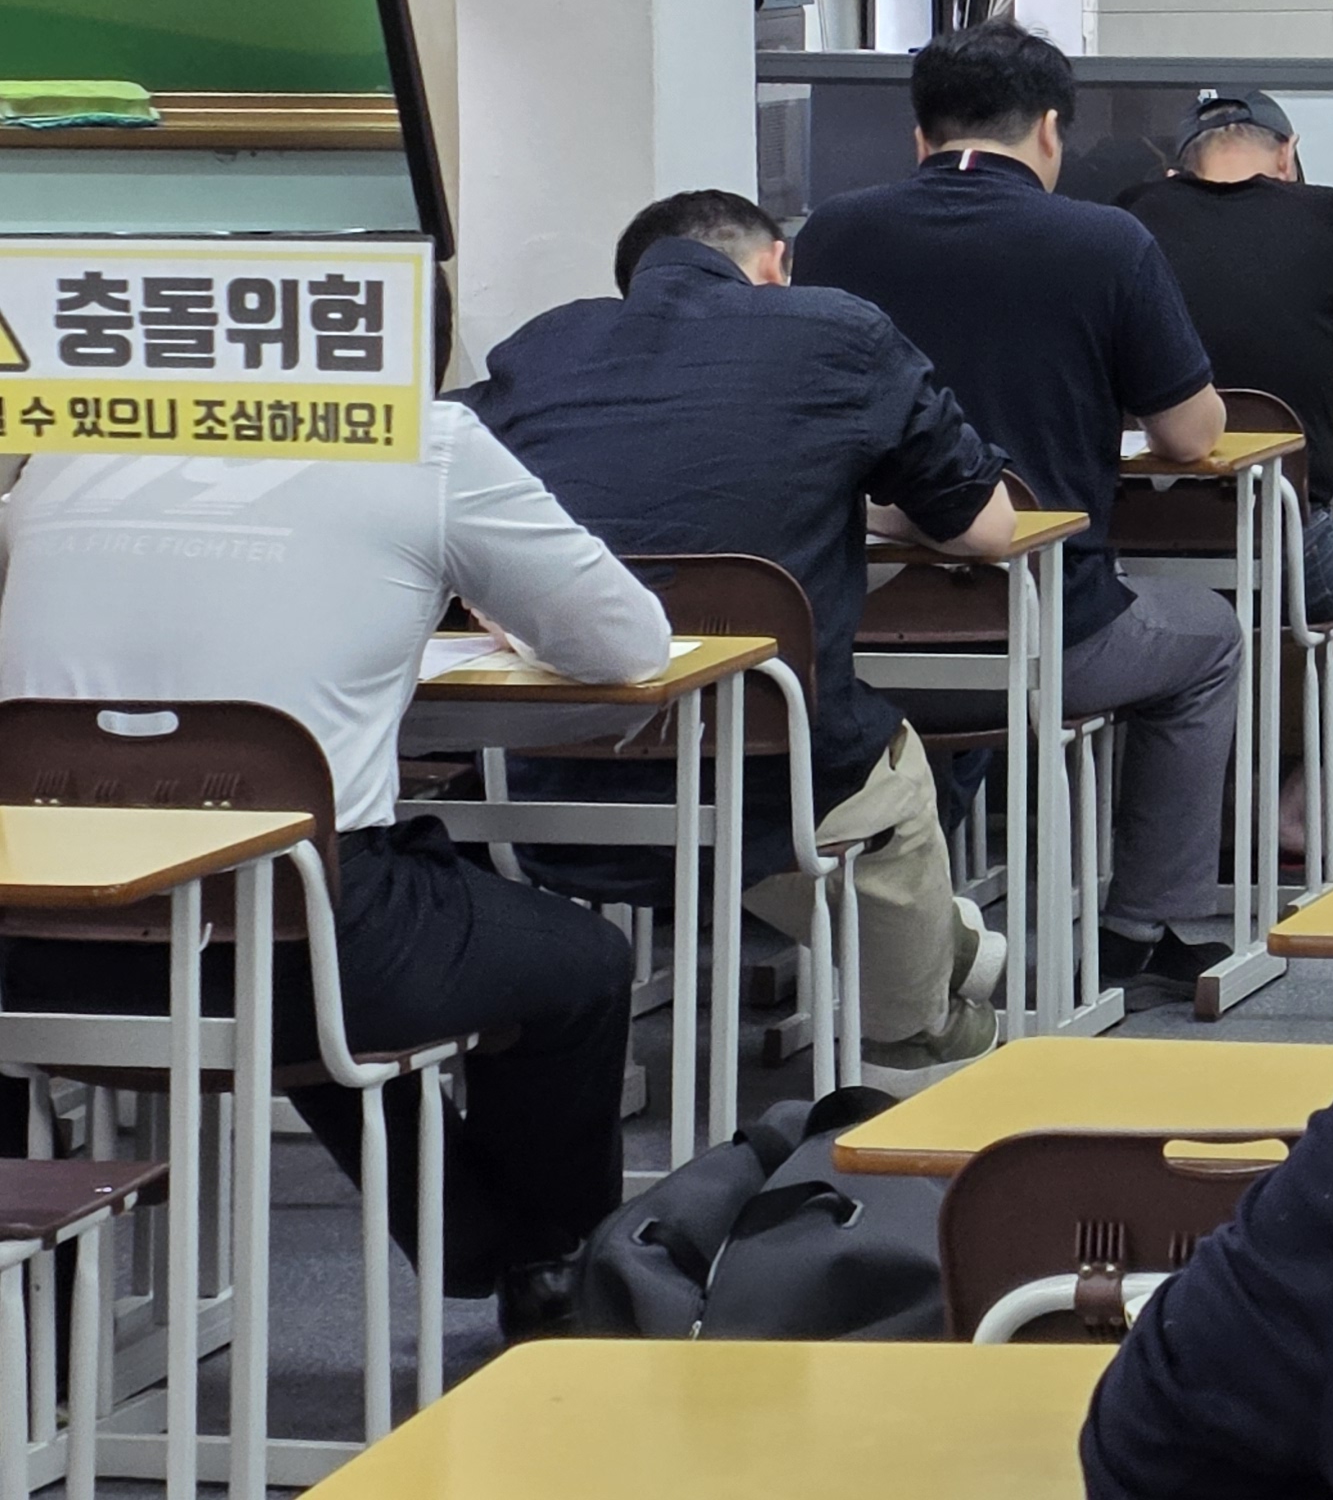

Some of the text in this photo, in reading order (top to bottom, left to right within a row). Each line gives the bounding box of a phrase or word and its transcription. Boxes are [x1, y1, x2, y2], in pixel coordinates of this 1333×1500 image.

[54, 270, 385, 373] 충돌위험
[20, 396, 56, 437] 수
[68, 396, 178, 440] 있으니
[192, 399, 394, 446] 조심하세요!
[156, 535, 287, 563] FIGHTER
